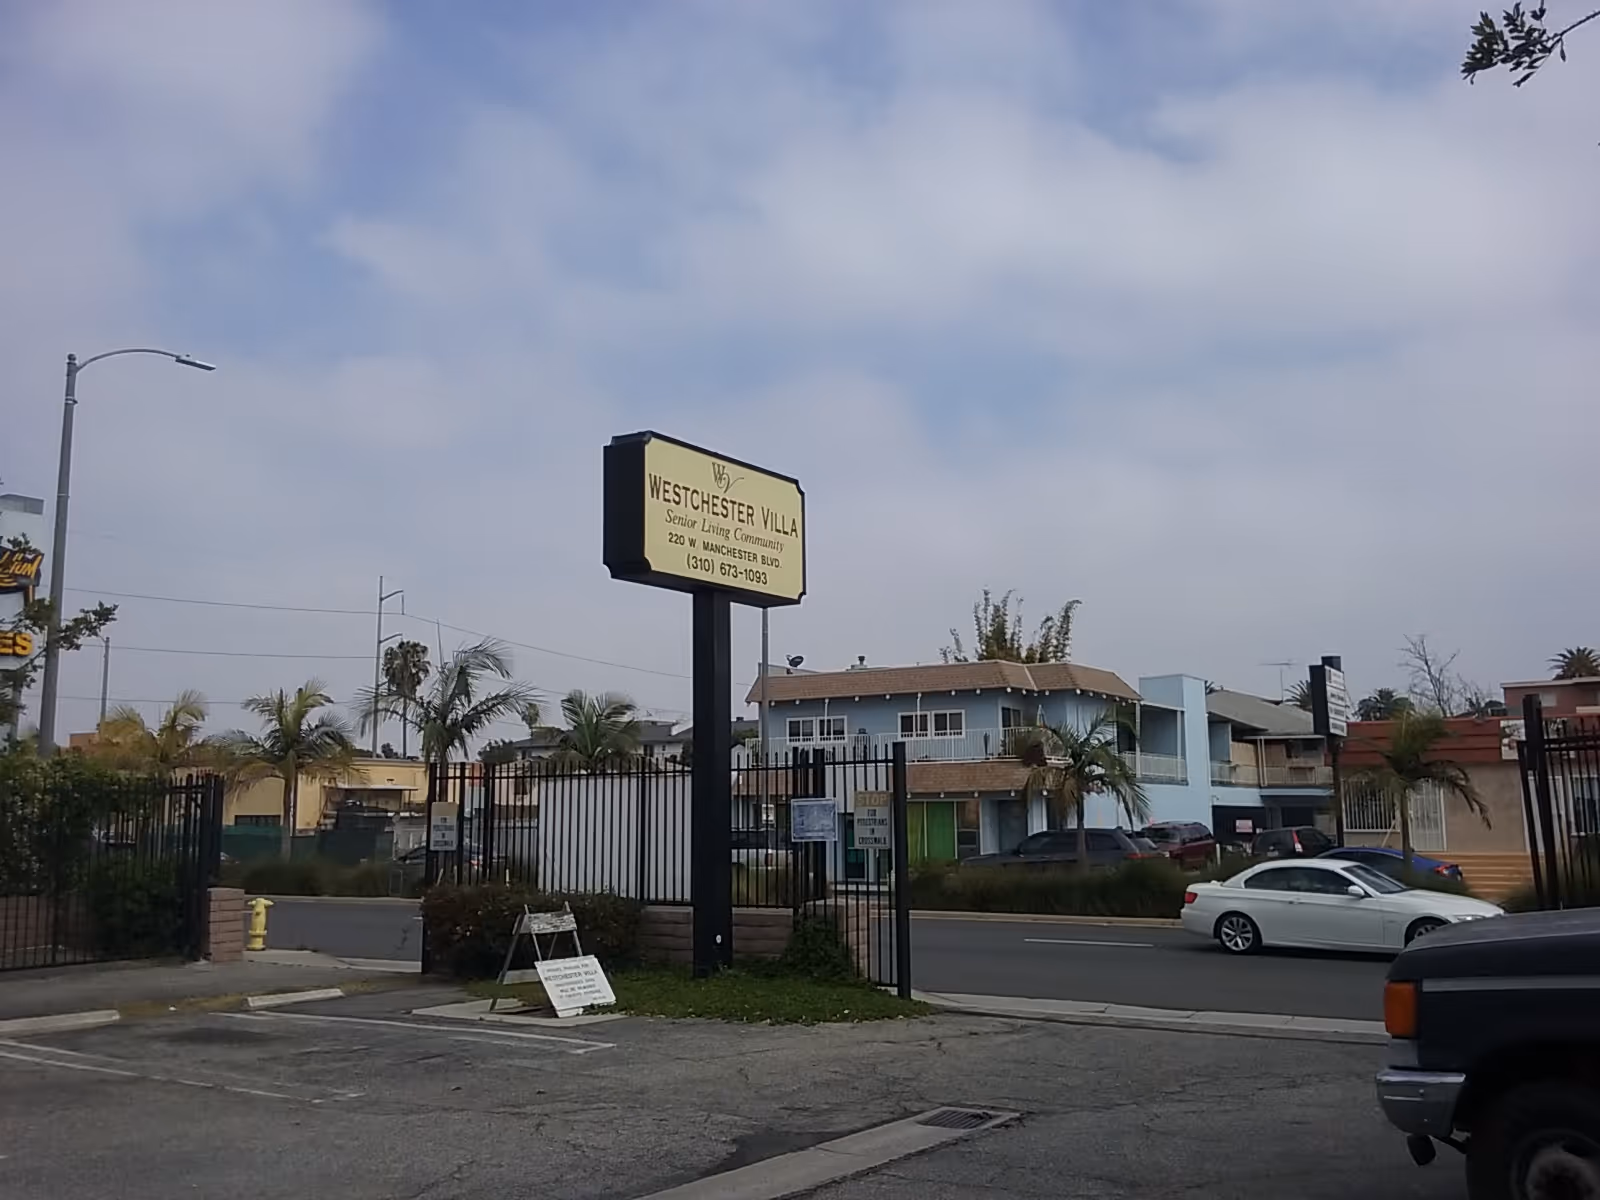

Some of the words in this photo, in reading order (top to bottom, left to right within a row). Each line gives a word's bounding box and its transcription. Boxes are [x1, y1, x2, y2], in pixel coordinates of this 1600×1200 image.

[649, 473, 755, 526] WESTCHESTER
[761, 506, 799, 538] VILLA
[665, 509, 697, 529] Senior
[701, 518, 731, 541] Living
[734, 527, 785, 553] Community
[668, 532, 685, 545] 220
[702, 540, 758, 563] MANCHESTER
[761, 554, 783, 568] BLVD.
[686, 553, 715, 574] (310)
[720, 562, 768, 585] 673-1093
[857, 793, 887, 805] STOP
